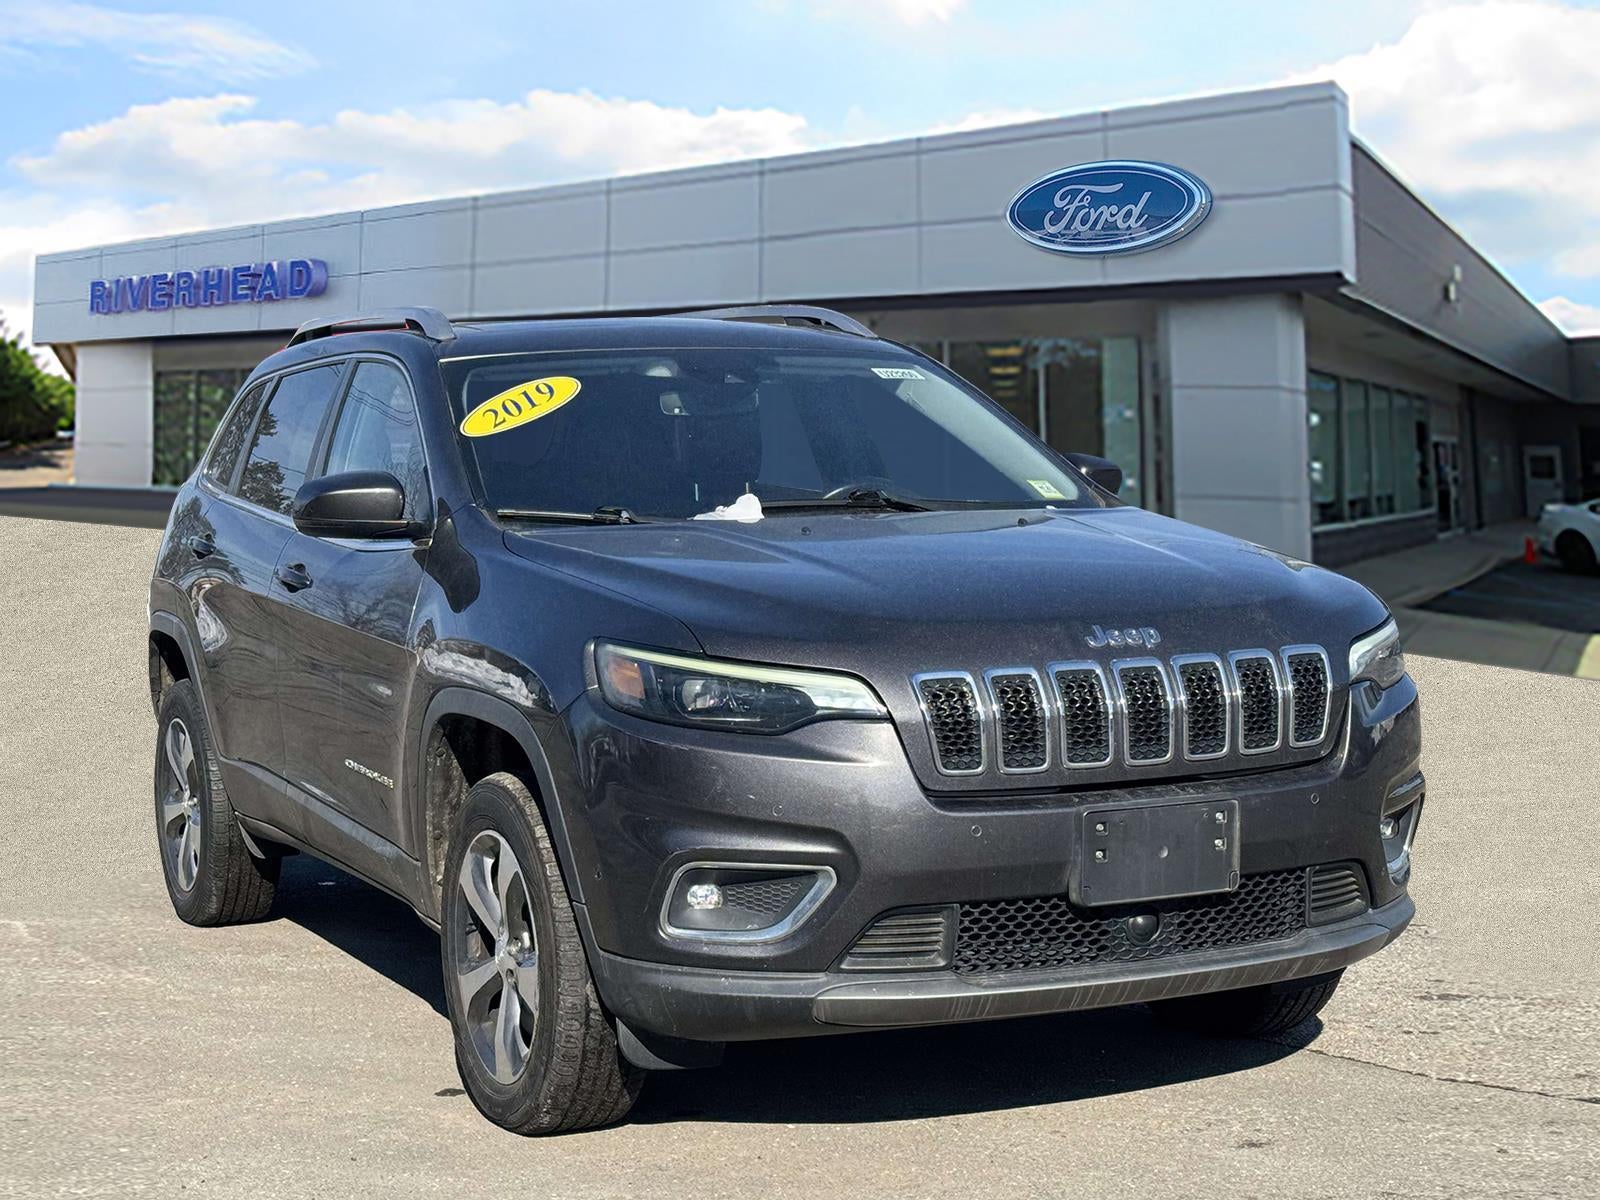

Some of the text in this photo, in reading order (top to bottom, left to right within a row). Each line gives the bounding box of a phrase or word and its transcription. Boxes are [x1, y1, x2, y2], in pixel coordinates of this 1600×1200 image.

[1043, 182, 1152, 233] Ford
[90, 259, 316, 314] RIVERHEAD
[482, 382, 555, 429] 2019
[1084, 624, 1162, 649] Jeep
